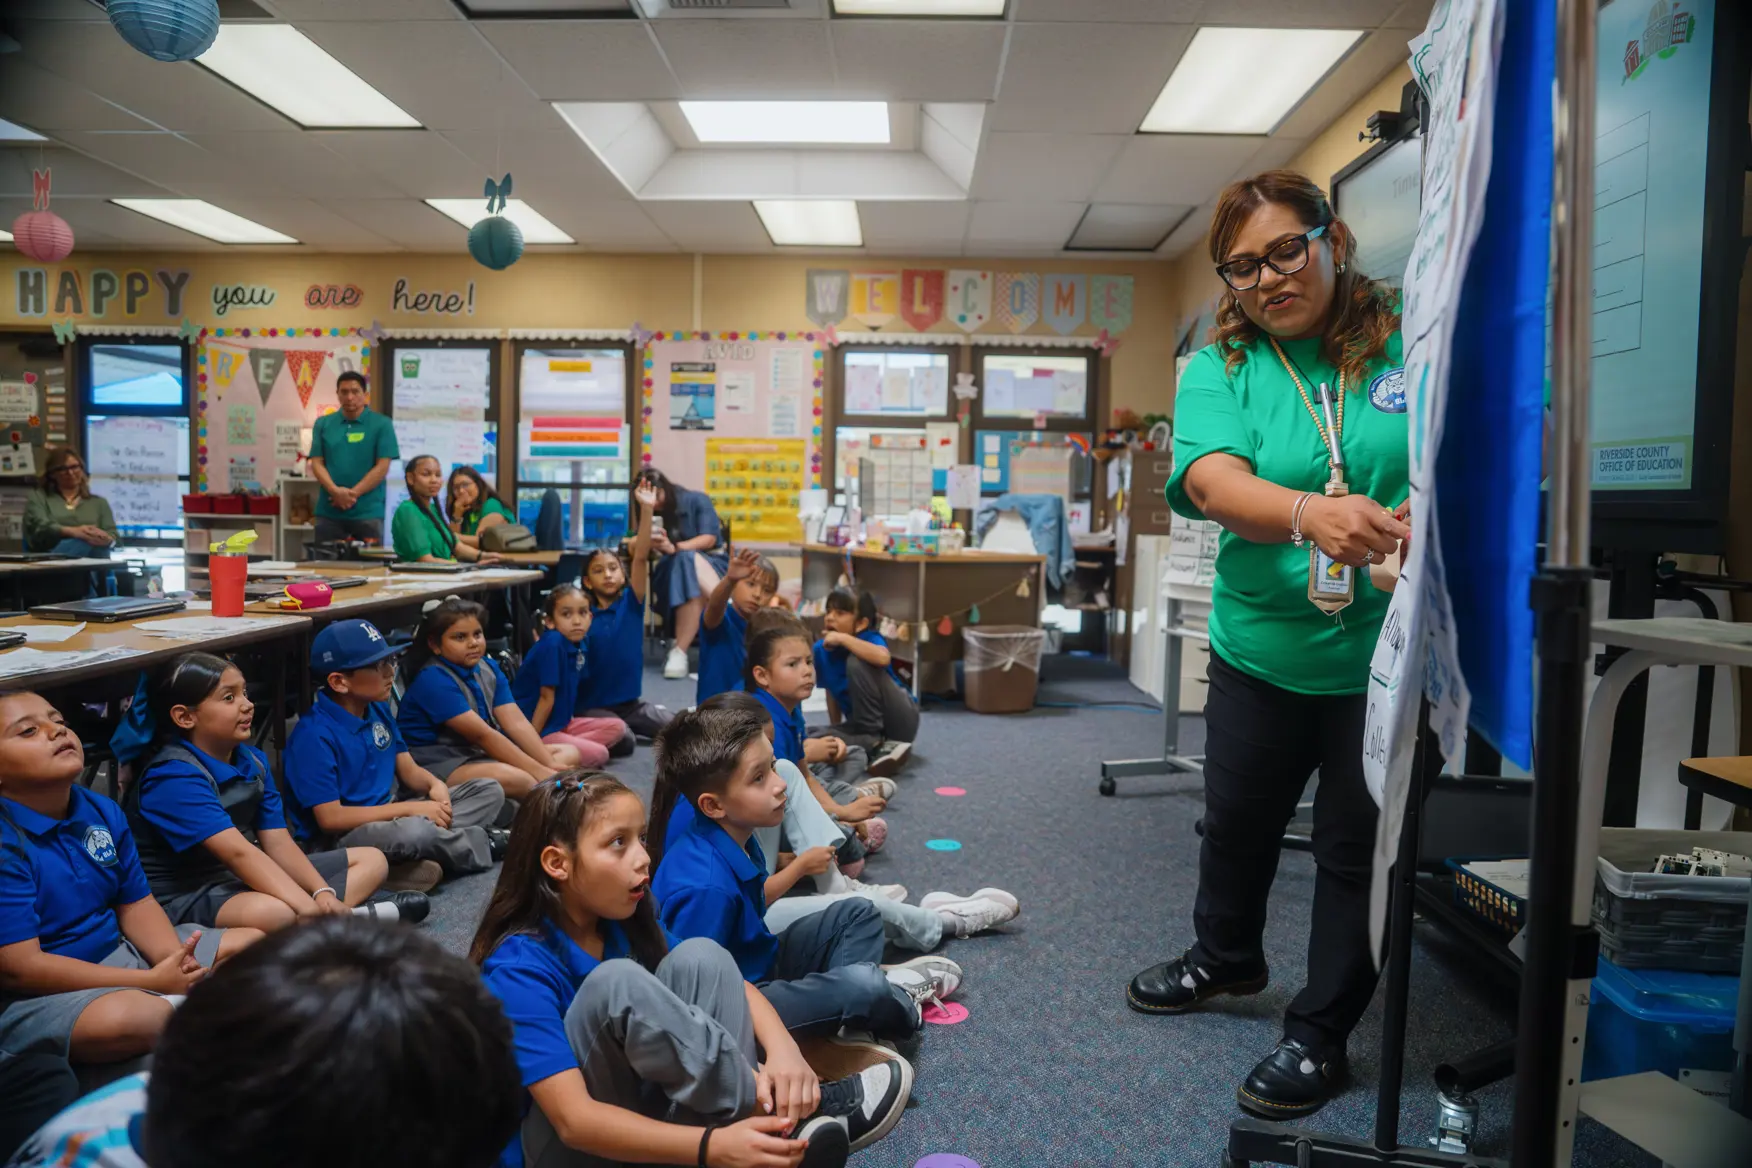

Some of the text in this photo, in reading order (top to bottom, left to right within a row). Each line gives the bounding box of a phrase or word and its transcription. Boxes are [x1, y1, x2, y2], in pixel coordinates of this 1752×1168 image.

[17, 269, 474, 316] HAPPY you are here!
[814, 274, 1120, 319] WELCOME
[703, 344, 755, 360] AVID
[1600, 446, 1670, 460] RIVERSIDE COUNTY
[1599, 458, 1683, 472] OFFICE OF EDUCATION
[360, 623, 382, 642] LA
